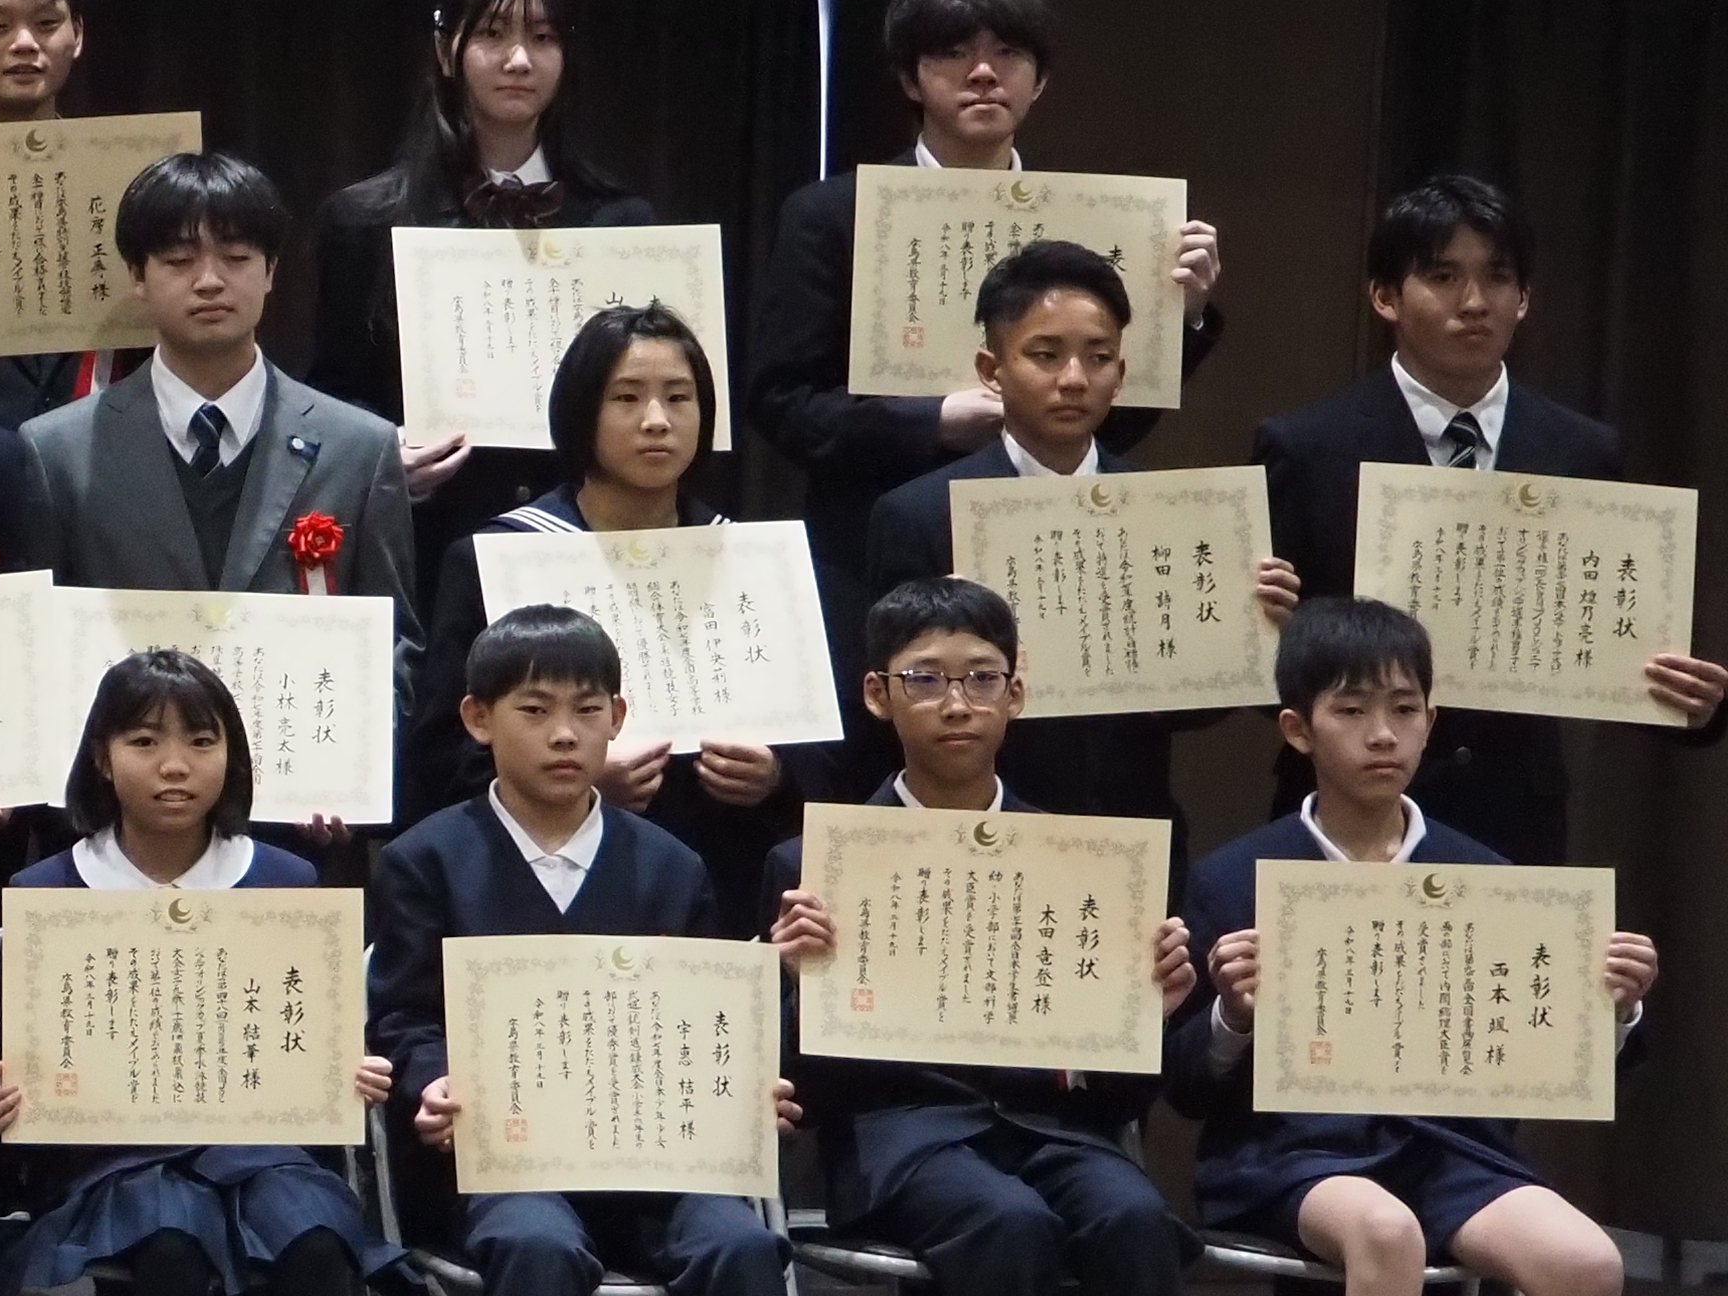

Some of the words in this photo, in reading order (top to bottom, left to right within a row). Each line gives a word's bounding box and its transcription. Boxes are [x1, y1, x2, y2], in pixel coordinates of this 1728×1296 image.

[1192, 540, 1221, 623] 表彰状
[1613, 553, 1638, 639] 表彰状
[738, 592, 768, 663] 表彰状
[277, 674, 296, 775] 小林亮太様
[312, 668, 336, 743] 表彰状
[1032, 904, 1058, 1015] 木田竜登様
[1075, 893, 1099, 979] 表彰状
[60, 973, 74, 1069] 広島県教育委員会
[280, 966, 306, 1053] 表彰状
[1528, 943, 1553, 1029] 表彰状
[508, 1018, 522, 1115] 広島県教育委員会
[713, 1011, 733, 1097] 表彰状
